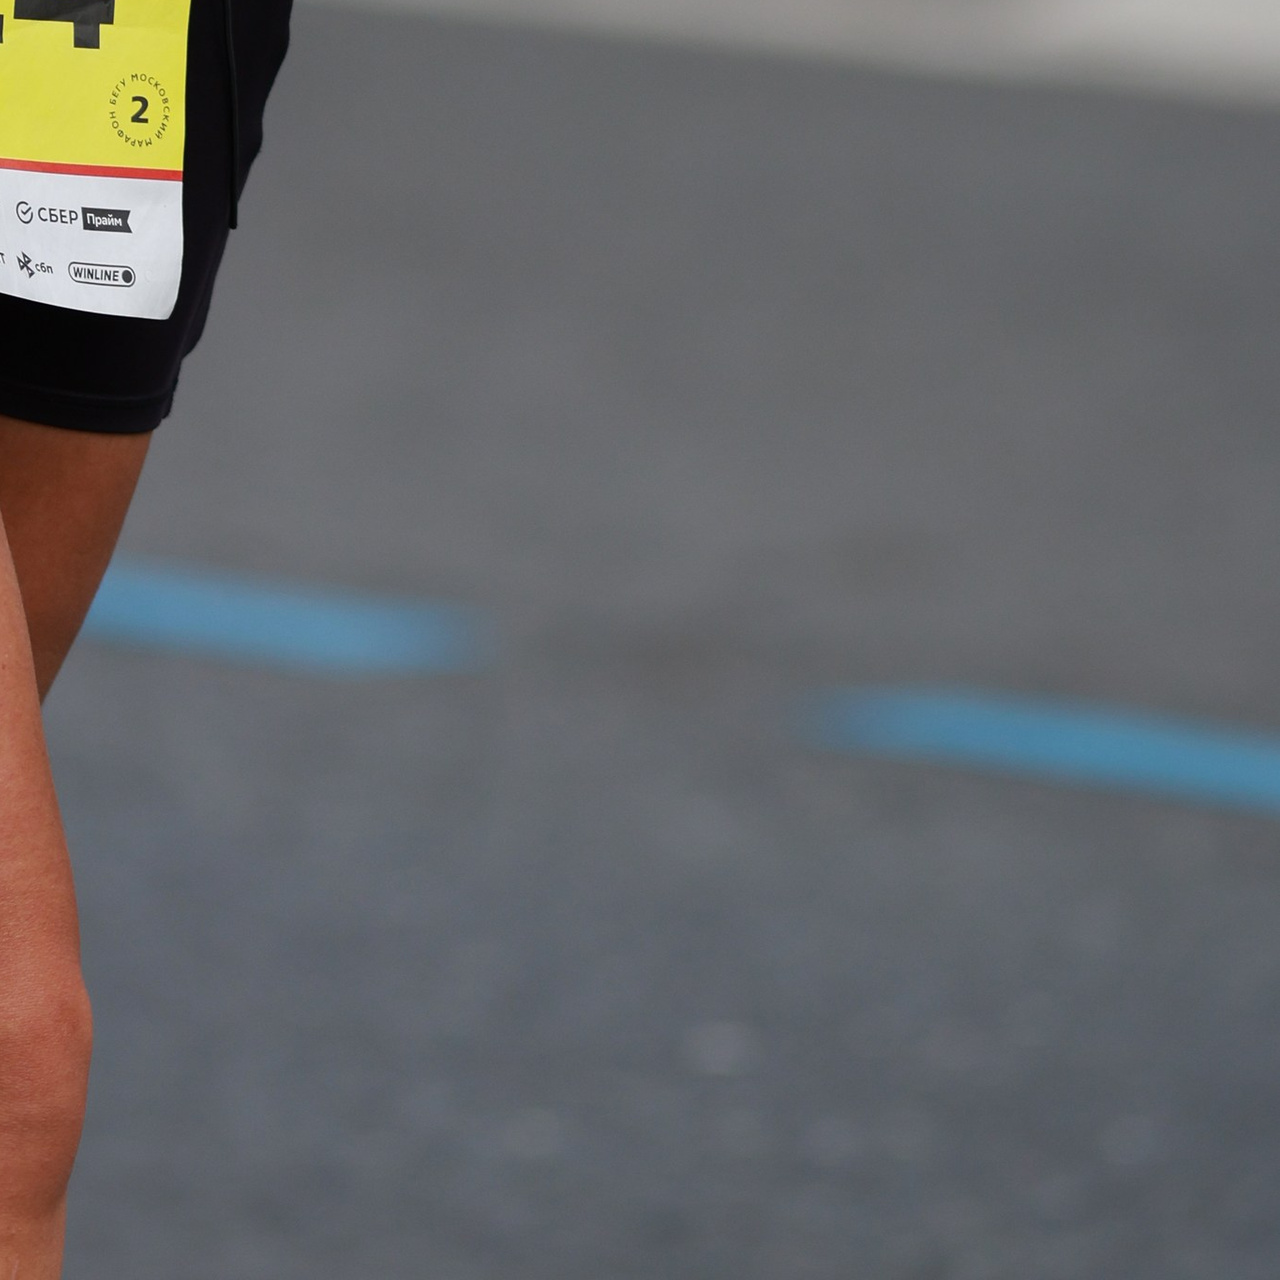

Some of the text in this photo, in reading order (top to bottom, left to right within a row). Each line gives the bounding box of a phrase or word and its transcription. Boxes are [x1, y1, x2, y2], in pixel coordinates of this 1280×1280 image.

[109, 73, 170, 147] БЕГУ МОСКОВСКИЙ МАРАФОН
[131, 95, 149, 124] 2
[38, 206, 123, 228] СБЕР Прайм
[35, 262, 54, 274] сбп
[73, 266, 120, 282] WINLINE
